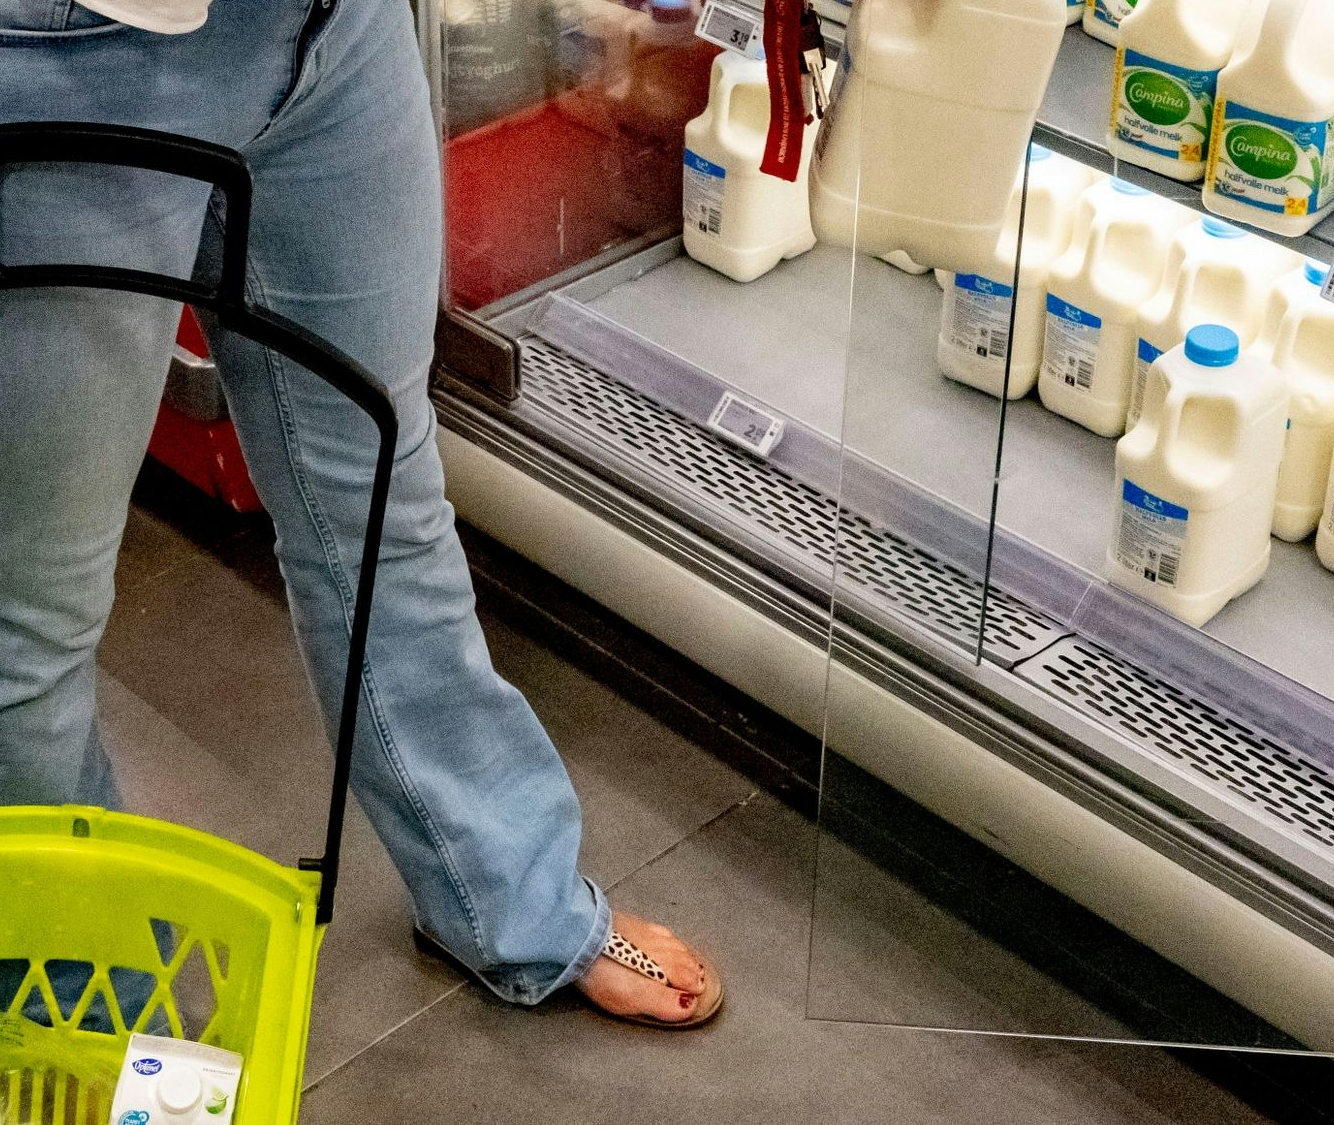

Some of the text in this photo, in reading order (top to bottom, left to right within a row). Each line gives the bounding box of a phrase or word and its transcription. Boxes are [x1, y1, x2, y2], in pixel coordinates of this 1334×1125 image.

[730, 29, 750, 45] 3.19
[1129, 82, 1184, 109] Campina
[1124, 115, 1159, 135] halfvolle
[1230, 136, 1291, 161] Campina
[1224, 170, 1288, 196] halfvolle melk
